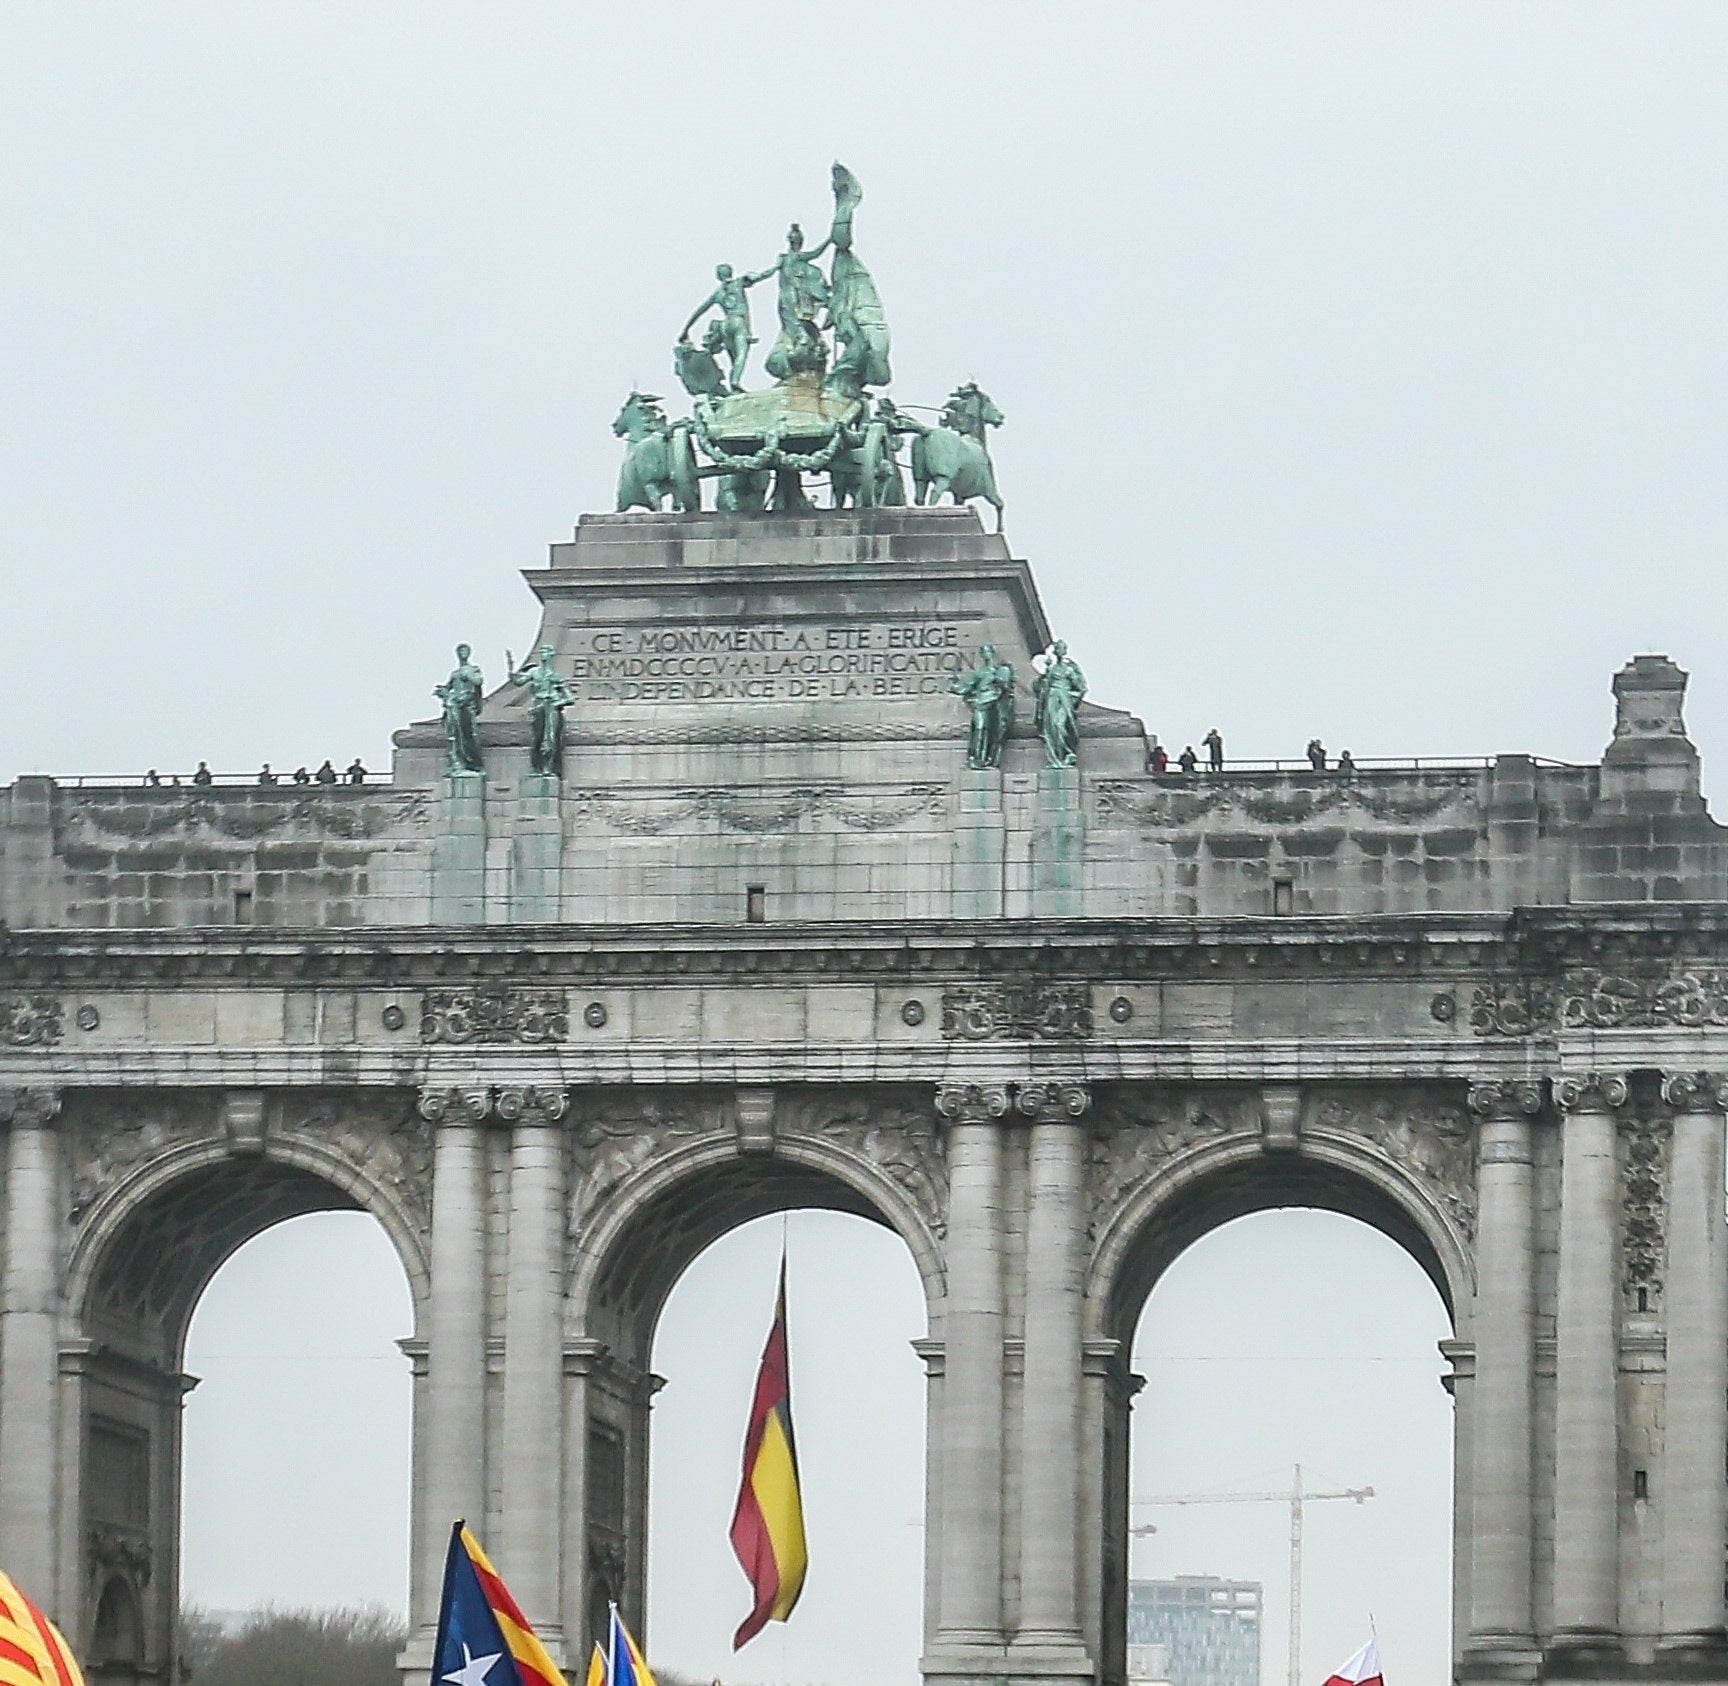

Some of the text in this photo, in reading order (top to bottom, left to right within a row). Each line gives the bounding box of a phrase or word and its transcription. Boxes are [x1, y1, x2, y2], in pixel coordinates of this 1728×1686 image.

[591, 633, 622, 652] CE
[793, 632, 810, 649] A
[573, 659, 602, 677] EN
[735, 657, 753, 674] A
[798, 652, 976, 673] GLORIFICATION
[789, 680, 820, 697] DE
[830, 679, 861, 696] LA
